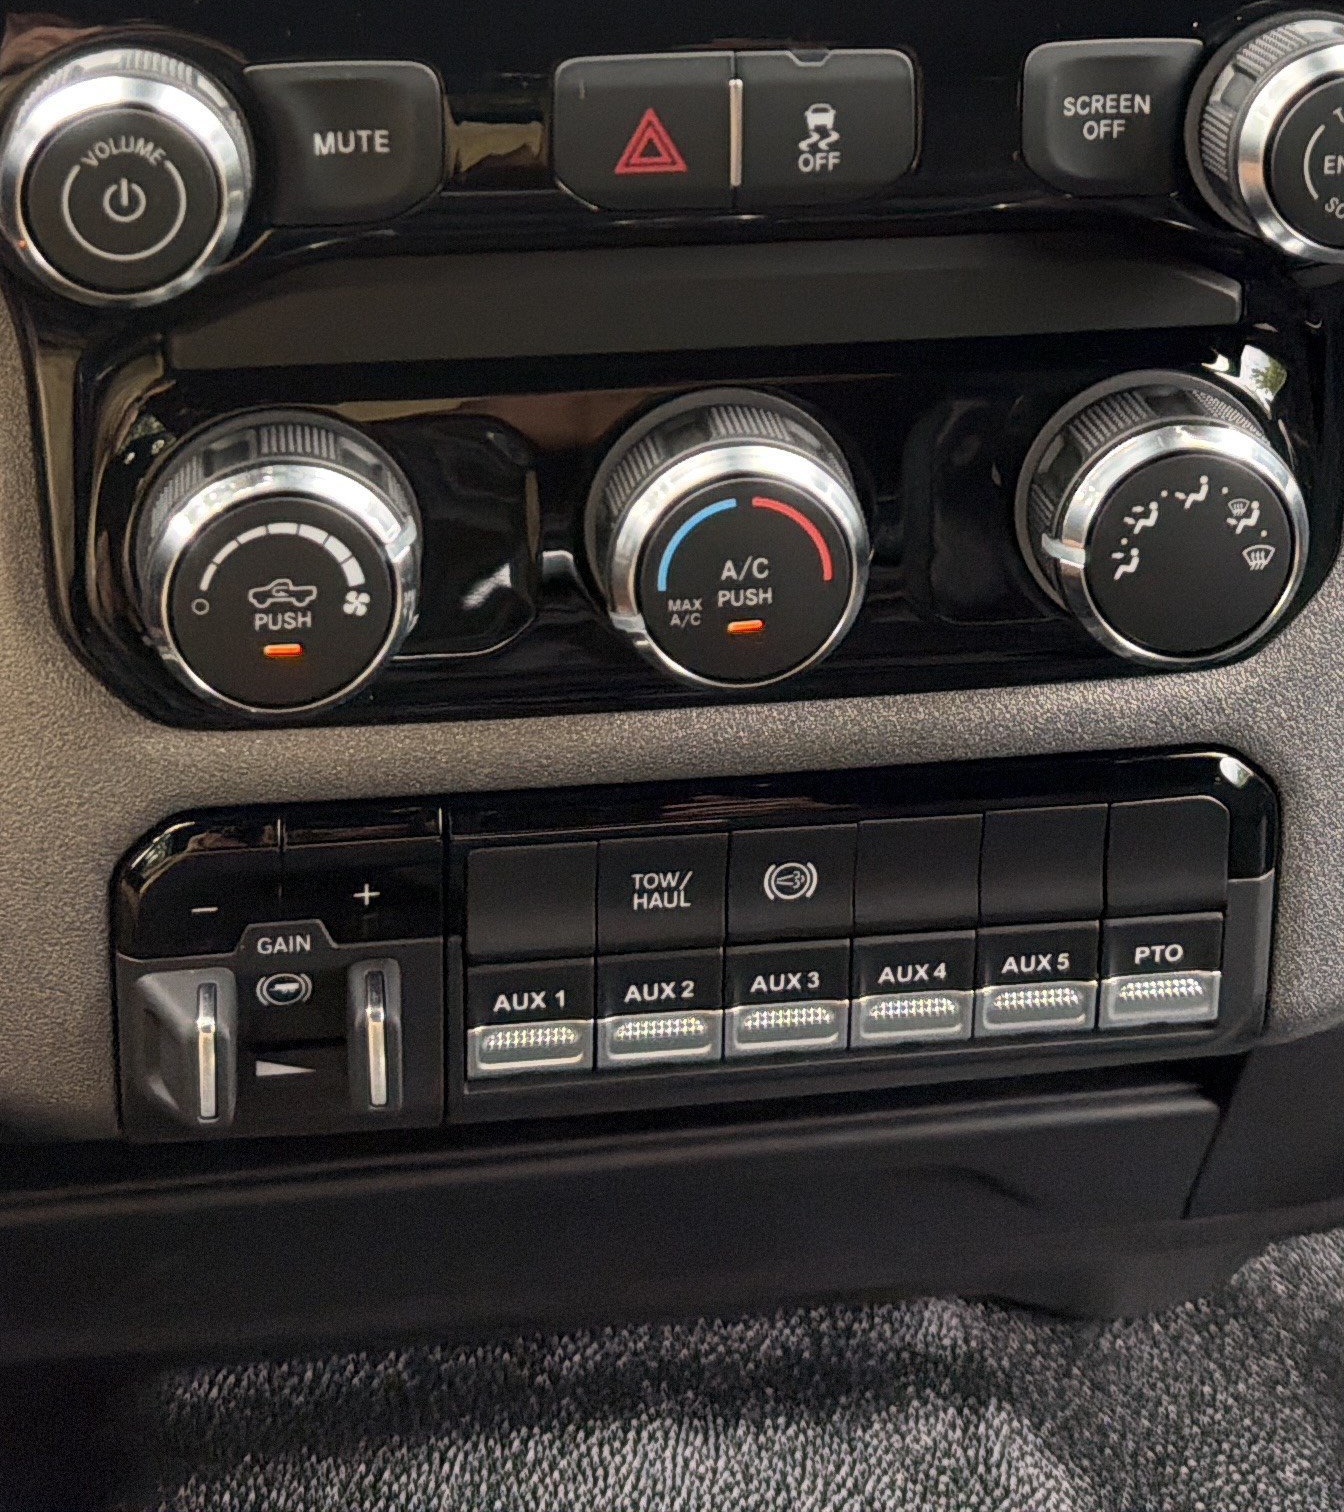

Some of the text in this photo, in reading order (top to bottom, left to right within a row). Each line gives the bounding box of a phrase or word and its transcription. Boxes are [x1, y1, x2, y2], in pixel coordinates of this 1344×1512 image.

[1063, 94, 1151, 117] SCREEN
[1082, 119, 1125, 141] OFF
[80, 135, 166, 168] VOLUME
[313, 130, 390, 155] MUTE
[798, 152, 841, 172] OFF
[721, 556, 770, 582] A/C
[668, 599, 703, 613] MAX
[717, 588, 773, 608] PUSH
[254, 611, 312, 630] PUSH
[670, 613, 702, 627] A/C
[631, 871, 693, 891] TOW/
[632, 891, 691, 911] HAUL
[257, 934, 311, 955] GAIN
[1134, 944, 1184, 965] PTO
[878, 962, 948, 984] AUX 4
[1001, 953, 1069, 974] AUX 5
[624, 980, 695, 1003] AUX 2
[751, 971, 820, 992] AUX 3
[493, 990, 566, 1011] AUX 1
